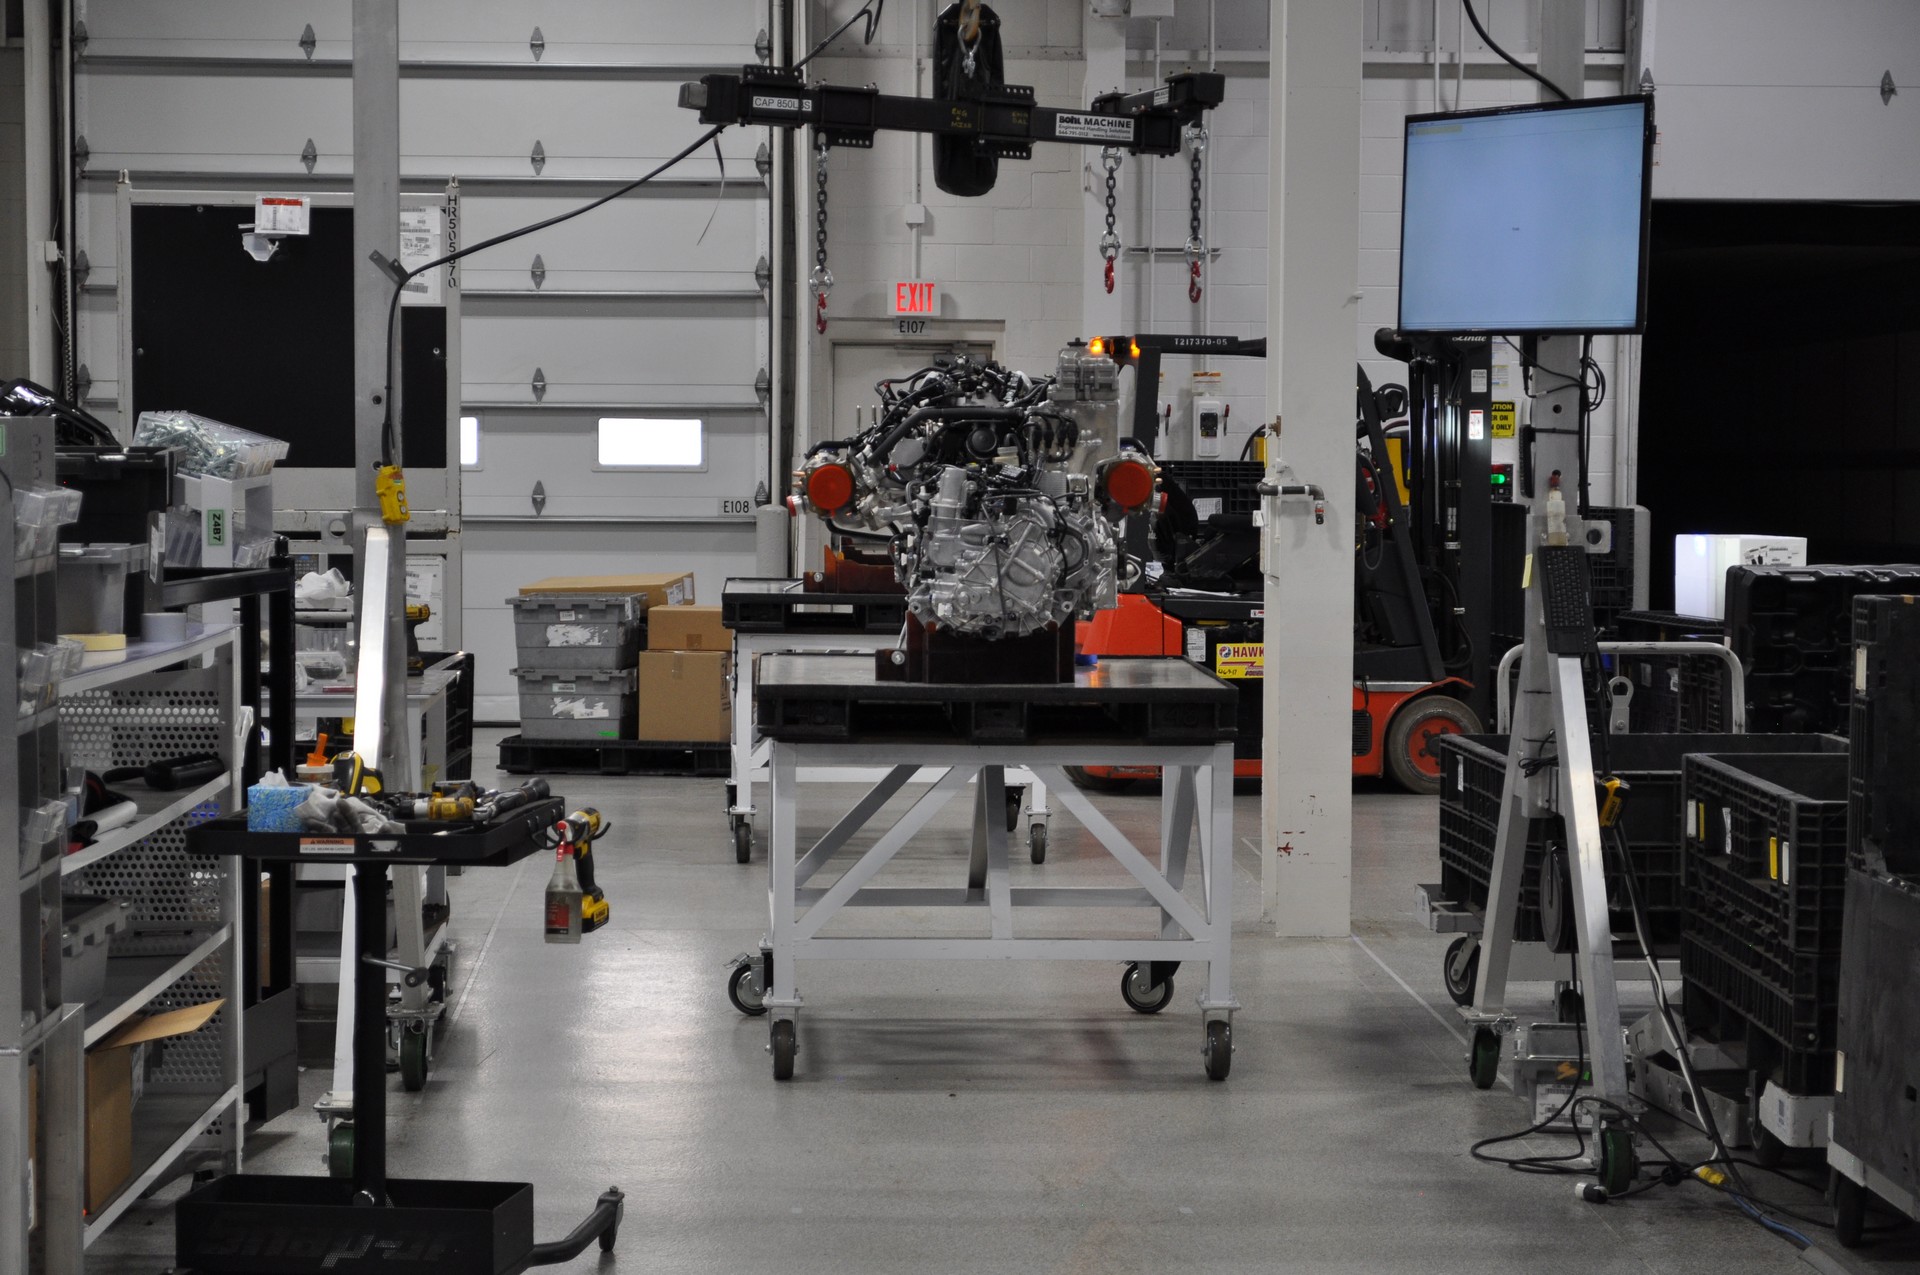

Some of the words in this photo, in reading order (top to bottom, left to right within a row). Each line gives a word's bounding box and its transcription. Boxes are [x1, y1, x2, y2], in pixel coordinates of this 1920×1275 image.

[755, 97, 774, 107] CAP
[1084, 118, 1132, 129] MACHINE
[896, 282, 935, 312] EXIT
[899, 320, 925, 334] E107
[1496, 423, 1512, 431] ONLY
[723, 500, 749, 513] E108
[213, 513, 221, 542] Z4B7
